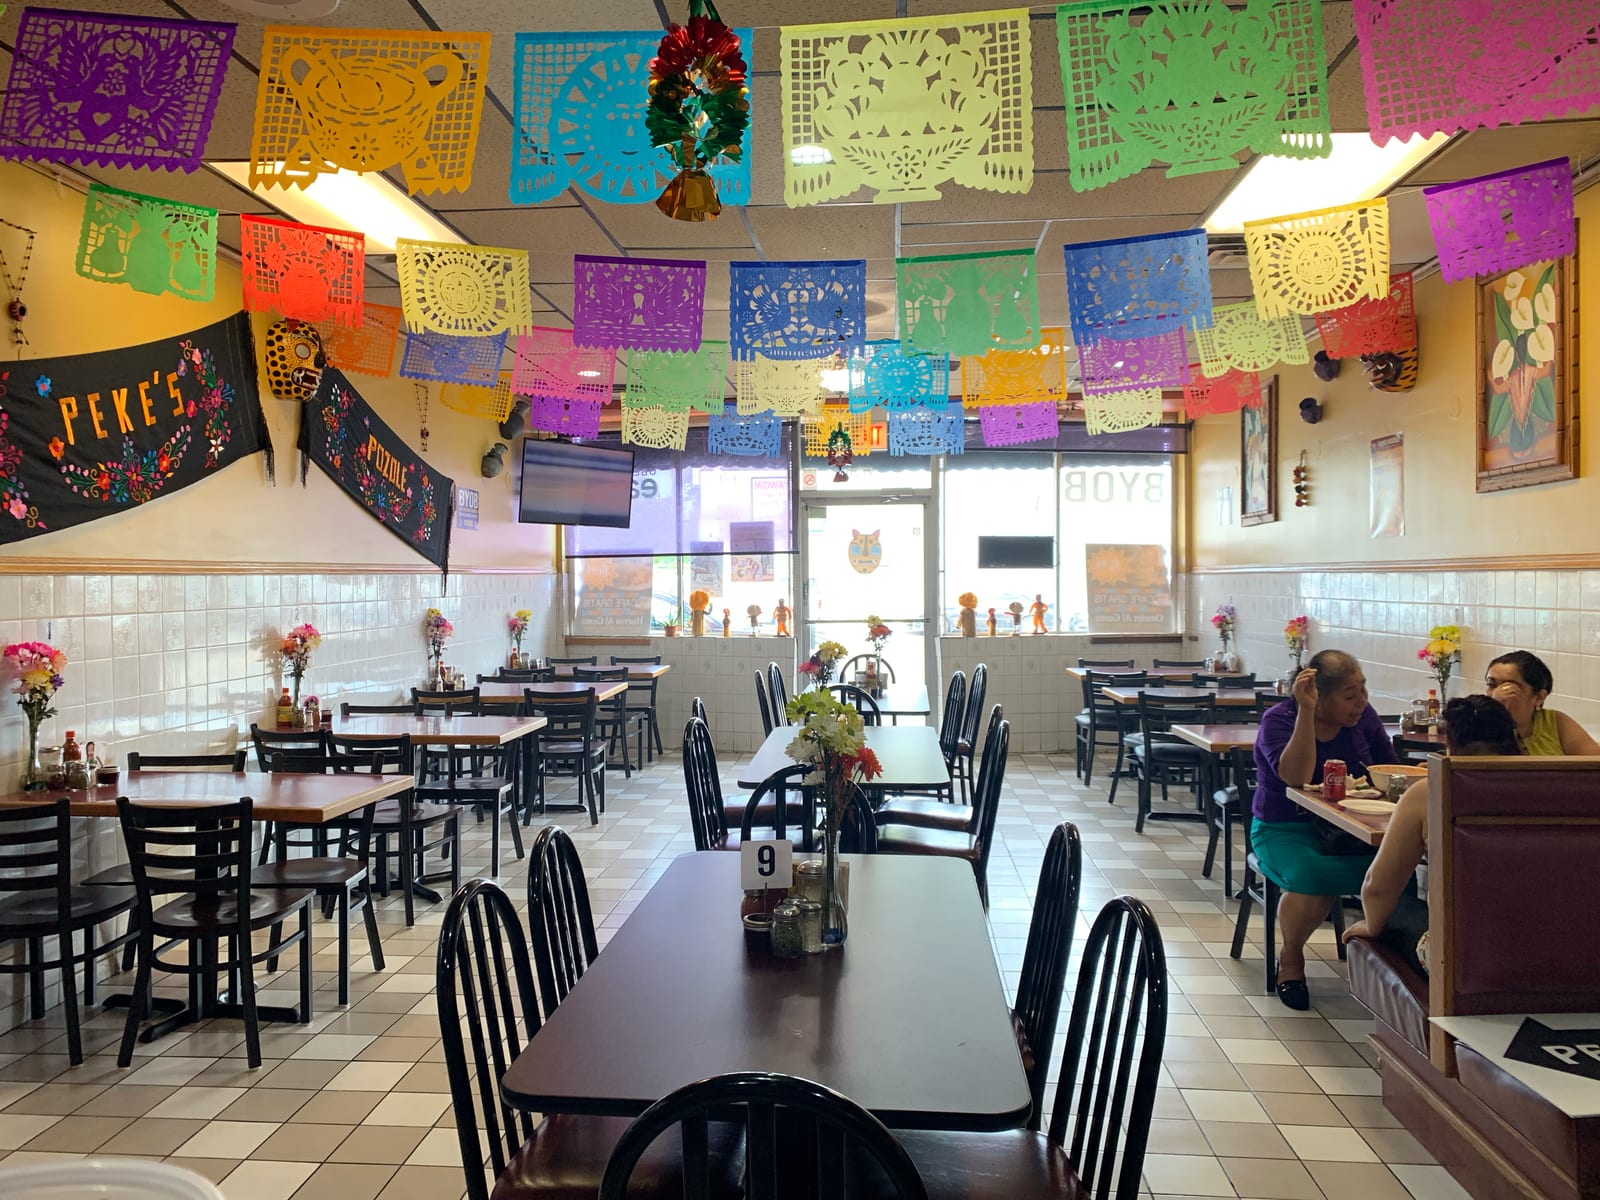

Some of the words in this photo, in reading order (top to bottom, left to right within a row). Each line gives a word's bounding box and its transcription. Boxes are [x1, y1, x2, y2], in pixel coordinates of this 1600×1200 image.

[58, 369, 186, 446] PEKE'S
[367, 433, 408, 493] POZOLE
[458, 489, 478, 509] BYOB
[757, 845, 776, 877] 9
